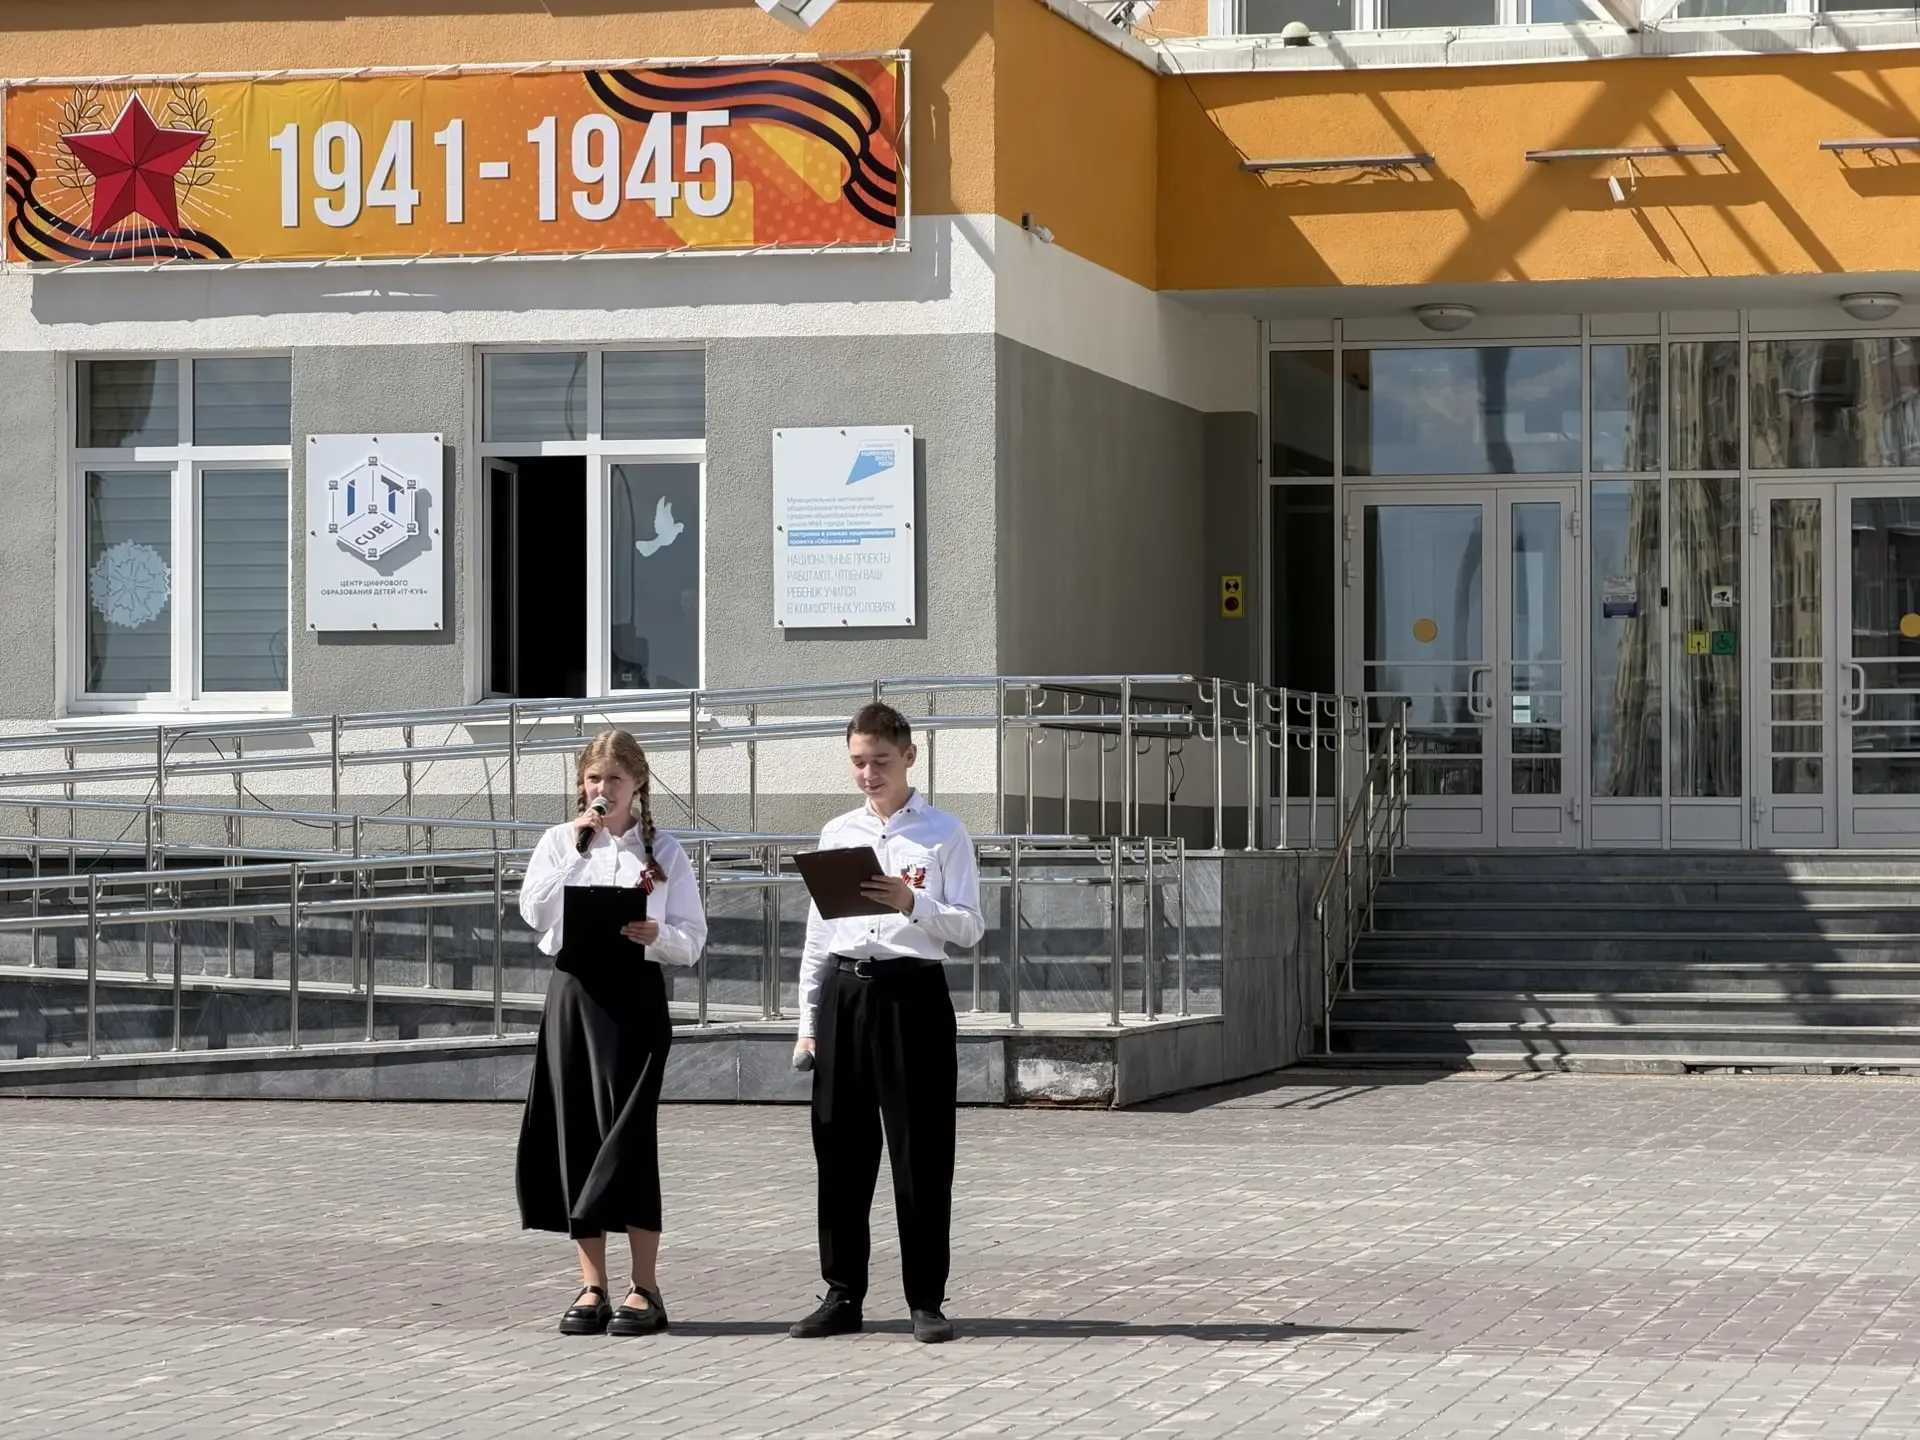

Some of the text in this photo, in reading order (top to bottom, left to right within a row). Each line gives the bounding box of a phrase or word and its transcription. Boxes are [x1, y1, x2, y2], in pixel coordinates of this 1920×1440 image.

[355, 519, 393, 546] CUBE
[787, 552, 891, 565] НАЦИОНАЛЬНЫЕ ПРОЕКТЫ
[835, 569, 862, 580] ЧТОБЫ
[863, 569, 883, 580] ВАШ
[824, 586, 856, 598] УЧИЛСЯ
[794, 602, 852, 614] КОМФОРТНЫХ
[853, 601, 896, 613] УСЛОВИЯХ
